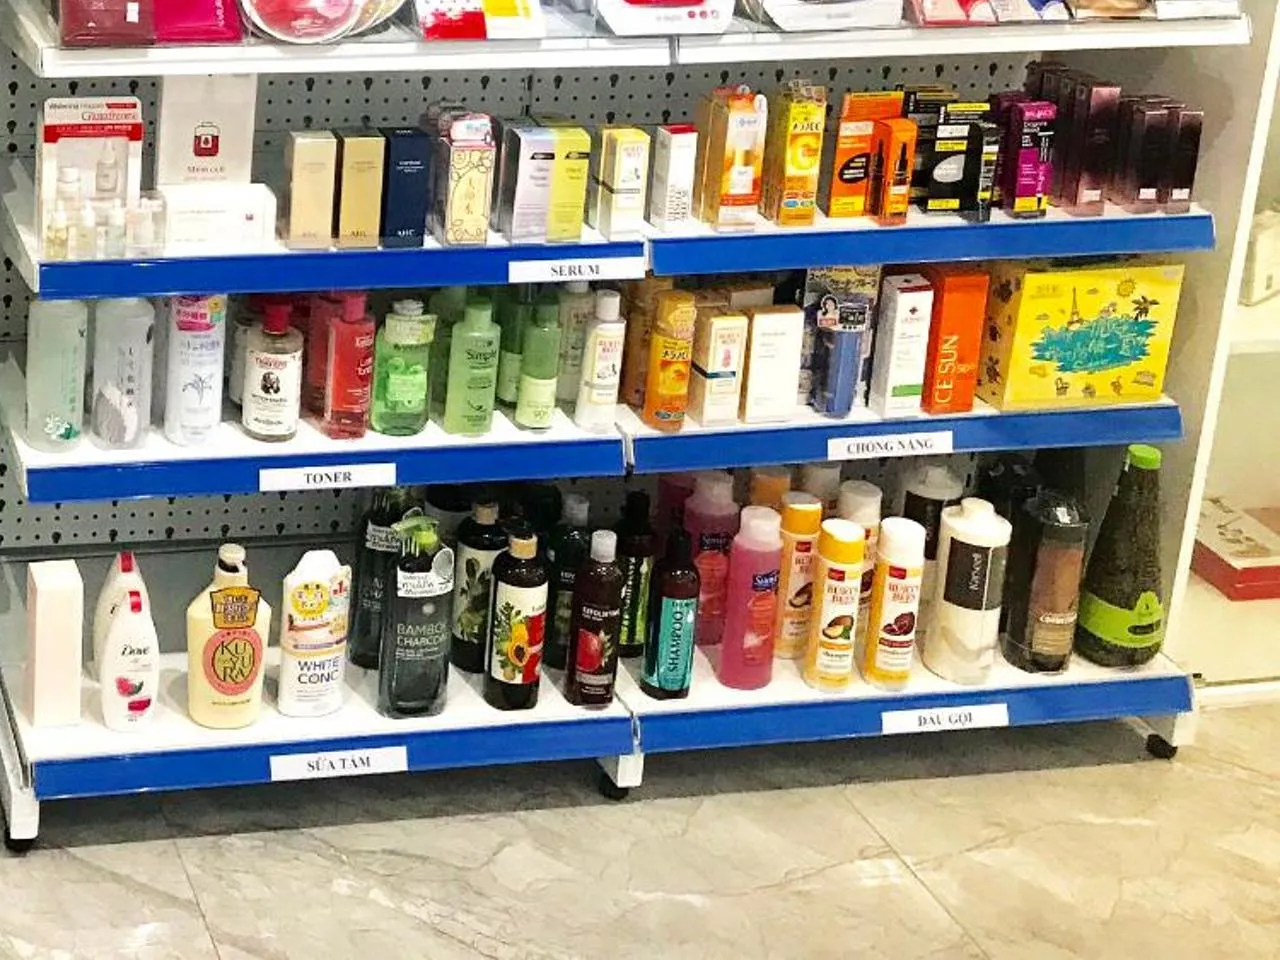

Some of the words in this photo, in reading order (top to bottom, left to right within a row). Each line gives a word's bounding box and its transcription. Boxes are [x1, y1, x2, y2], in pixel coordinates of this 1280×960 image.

[550, 262, 600, 277] SERUM
[939, 335, 960, 374] SUN
[303, 471, 354, 487] TONER
[121, 644, 150, 656] Dove
[669, 611, 684, 673] SHAMPOO
[297, 656, 341, 672] WHITE
[297, 670, 339, 685] CONC
